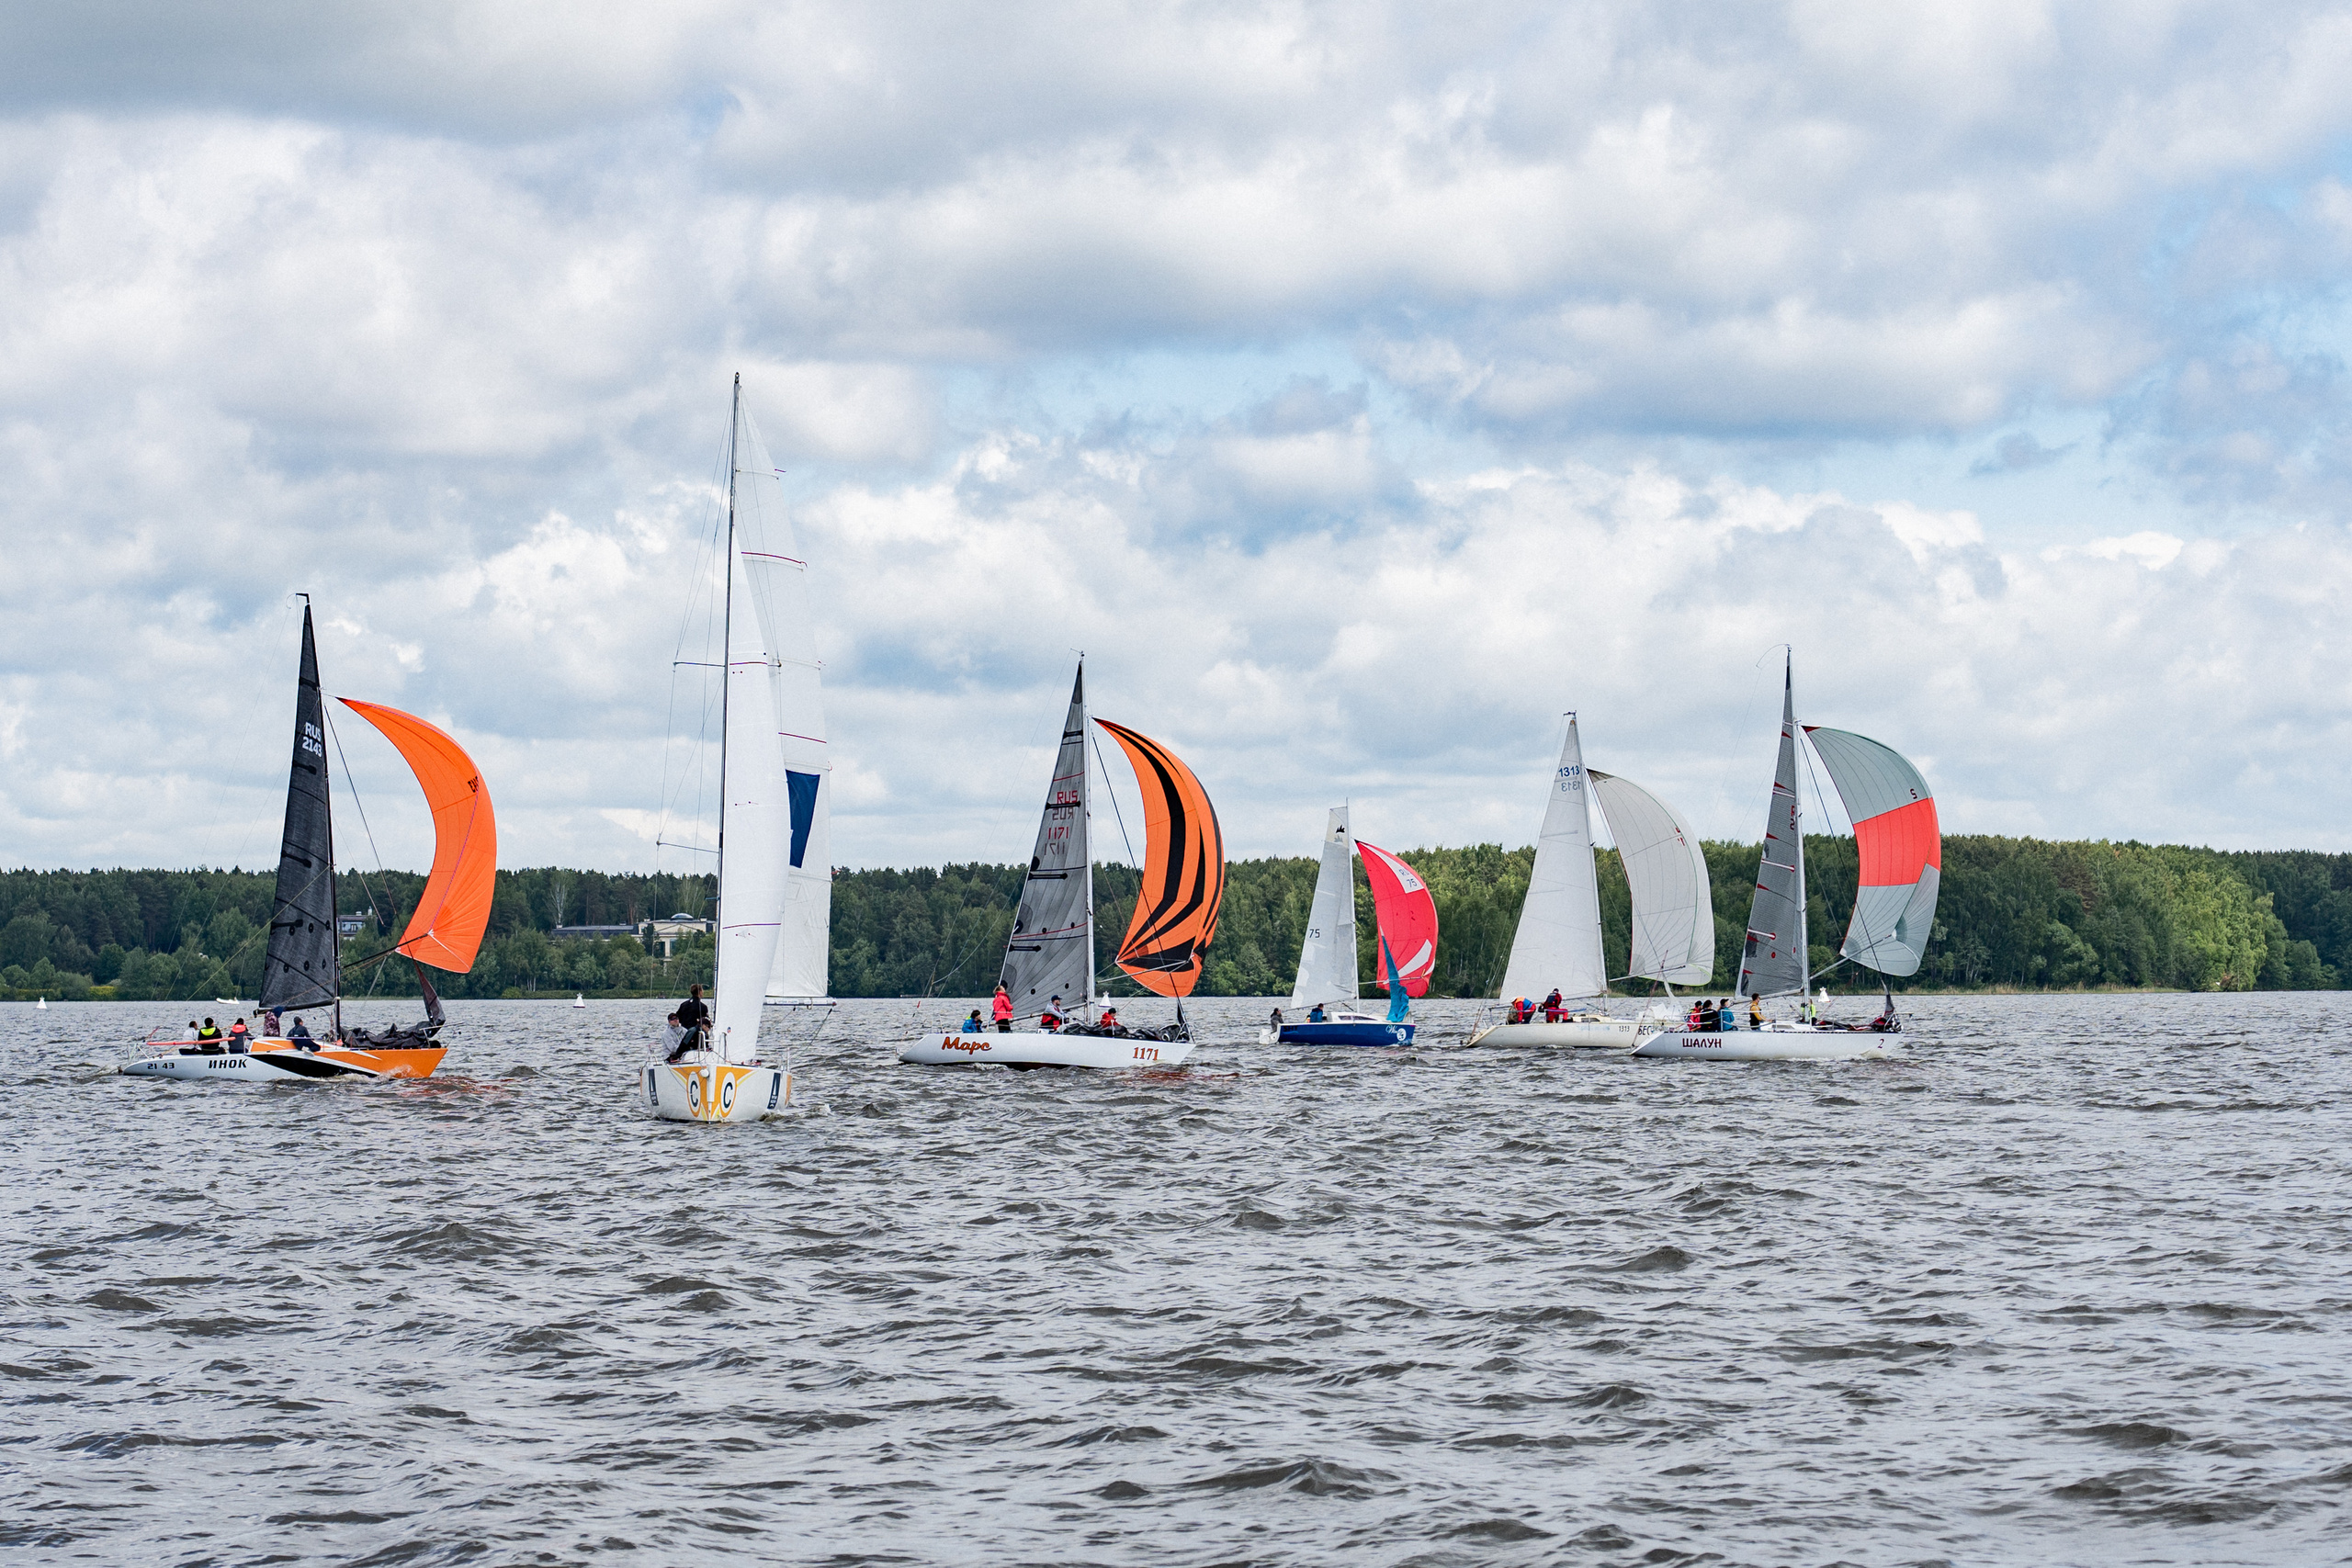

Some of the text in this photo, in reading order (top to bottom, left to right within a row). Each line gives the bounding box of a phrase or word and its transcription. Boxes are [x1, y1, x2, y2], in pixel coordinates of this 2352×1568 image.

[306, 721, 322, 742] RUS
[302, 736, 322, 758] 2143
[1558, 764, 1579, 777] 1313
[1057, 790, 1078, 804] RUS
[1048, 827, 1069, 840] 1171
[1406, 878, 1418, 887] 75
[1309, 929, 1320, 938] 75
[941, 1036, 992, 1055] Марс
[1682, 1037, 1723, 1049] ШАЛУН
[1877, 1038, 1884, 1049] 2
[1132, 1046, 1159, 1061] 1171
[208, 1058, 247, 1069] ИНОК
[690, 1080, 698, 1108] C
[723, 1081, 733, 1109] C
